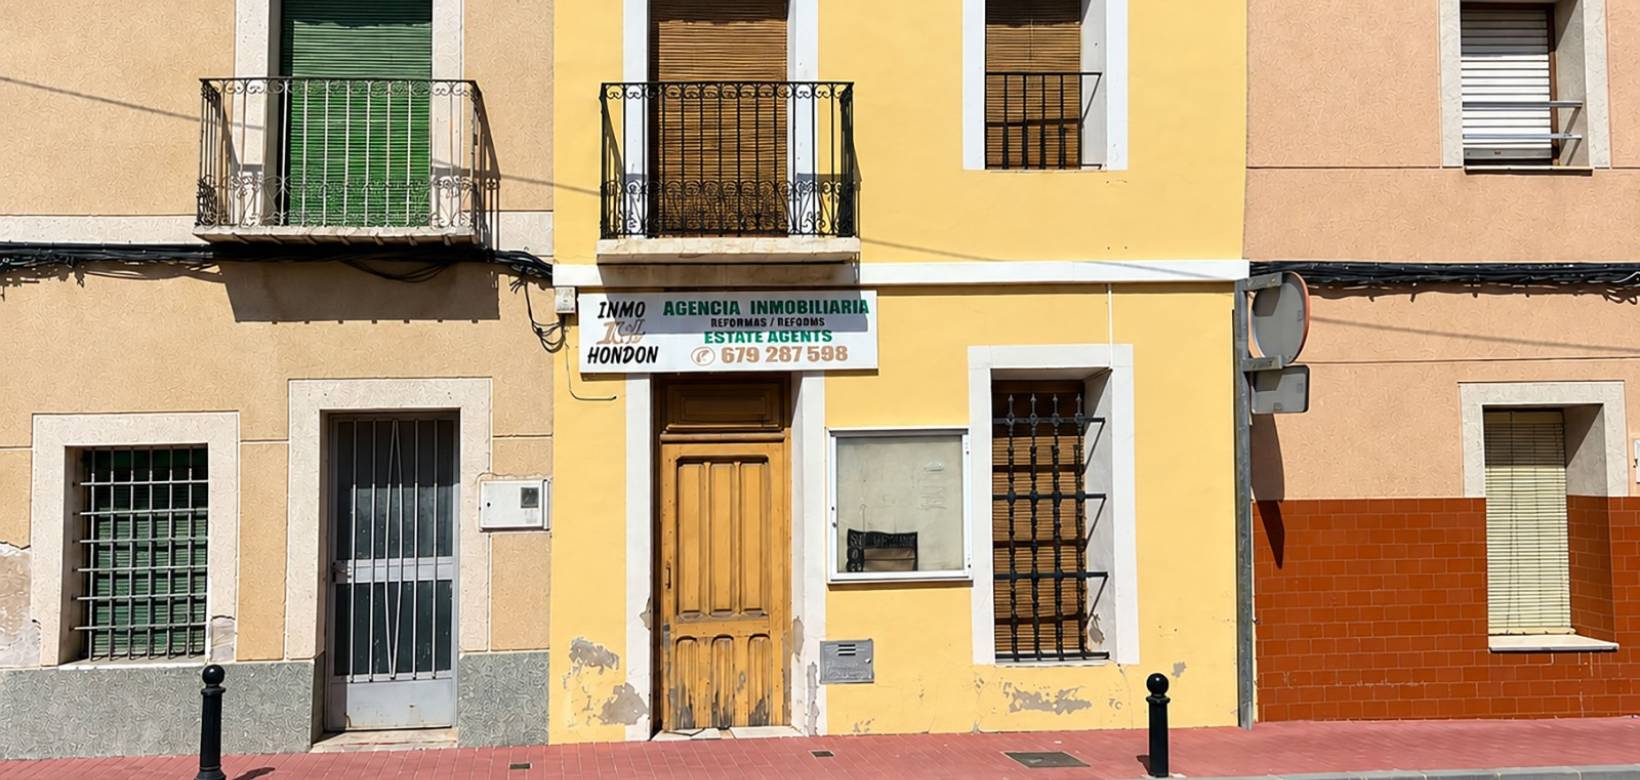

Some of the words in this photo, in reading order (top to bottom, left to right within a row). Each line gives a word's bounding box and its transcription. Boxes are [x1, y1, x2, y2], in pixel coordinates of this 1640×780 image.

[597, 301, 646, 319] INMO
[663, 300, 741, 316] AGENCIA
[750, 299, 869, 315] INMOBILIARIA
[711, 318, 767, 328] REFORMAS
[704, 331, 763, 344] ESTATE
[767, 330, 833, 343] AGENTS
[587, 346, 659, 364] HONDON
[721, 346, 760, 364] 679
[765, 346, 803, 363] 287
[807, 345, 848, 362] 598
